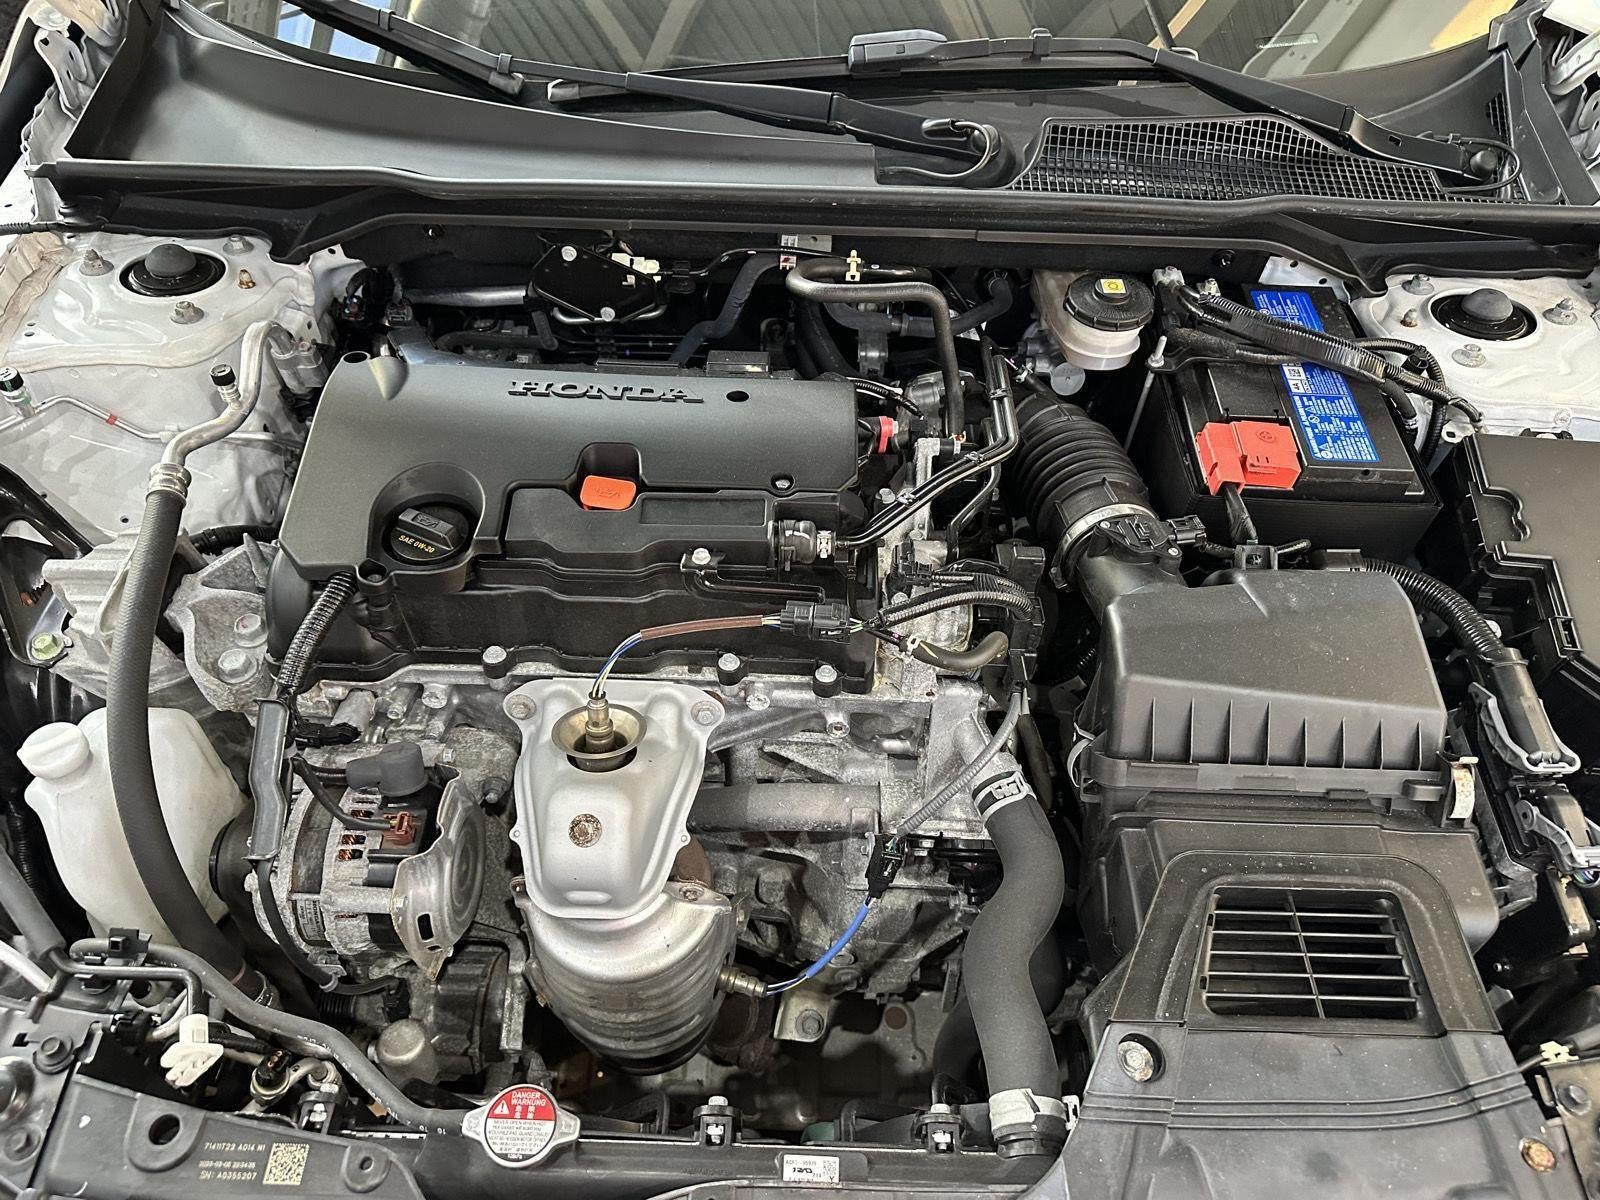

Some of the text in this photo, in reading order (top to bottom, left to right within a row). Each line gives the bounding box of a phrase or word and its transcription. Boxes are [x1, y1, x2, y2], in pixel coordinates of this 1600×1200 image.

[508, 381, 704, 403] HONDA
[398, 534, 436, 553] SAE 0W-20
[511, 1091, 541, 1099] DANGER
[511, 1098, 546, 1106] WARNUNG
